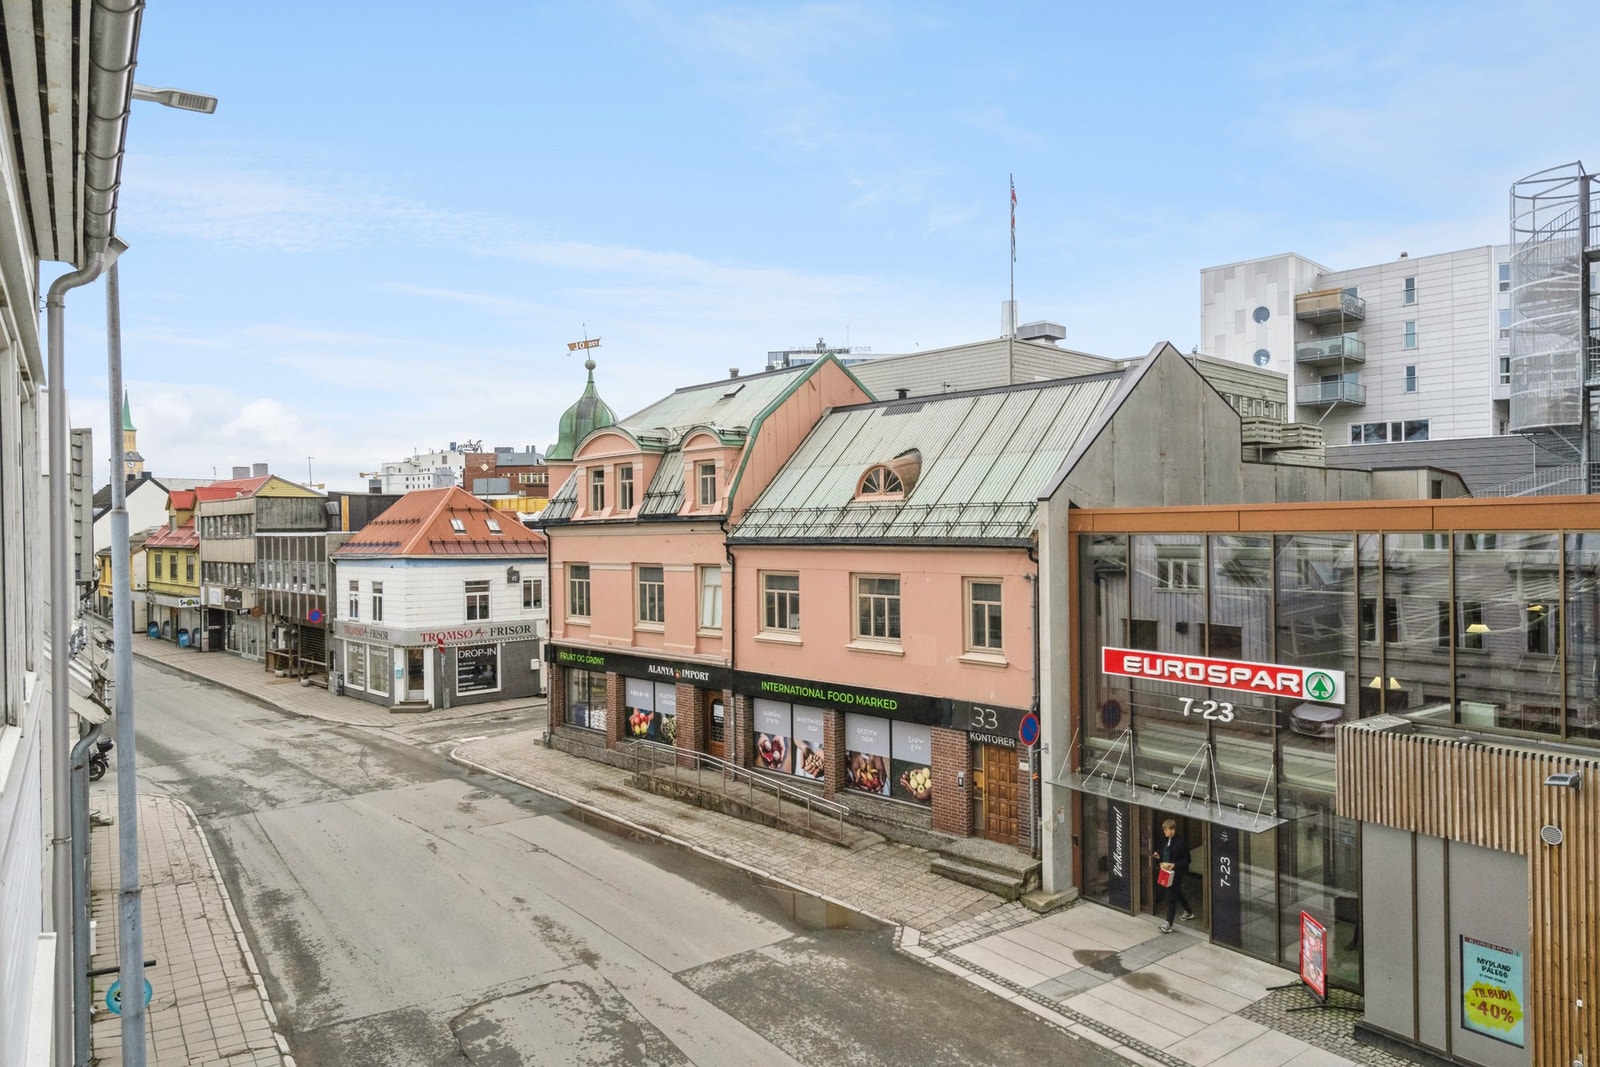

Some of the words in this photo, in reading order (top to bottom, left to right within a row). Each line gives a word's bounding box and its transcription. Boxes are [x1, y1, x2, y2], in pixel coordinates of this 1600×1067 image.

[420, 629, 473, 643] TROMSØ
[490, 624, 531, 637] FRISØR
[458, 647, 497, 659] DROP-IN
[560, 652, 576, 663] FRUKT
[577, 655, 585, 663] OG
[585, 655, 605, 666] GRØNT
[648, 665, 674, 676] ALANYA
[681, 669, 709, 681] IMPORT
[1123, 655, 1301, 693] EUROSPAR
[761, 680, 826, 701] INTERNATIONAL
[827, 690, 854, 705] FOOD
[855, 695, 898, 711] MARKED
[971, 706, 998, 730] 33
[1179, 697, 1234, 723] 7-23
[970, 732, 1015, 747] KONTORER
[1111, 805, 1123, 878] Velkommen!
[1220, 856, 1231, 887] 7-23
[1472, 988, 1511, 1000] TILBUD!
[1470, 1000, 1514, 1024] -40%
